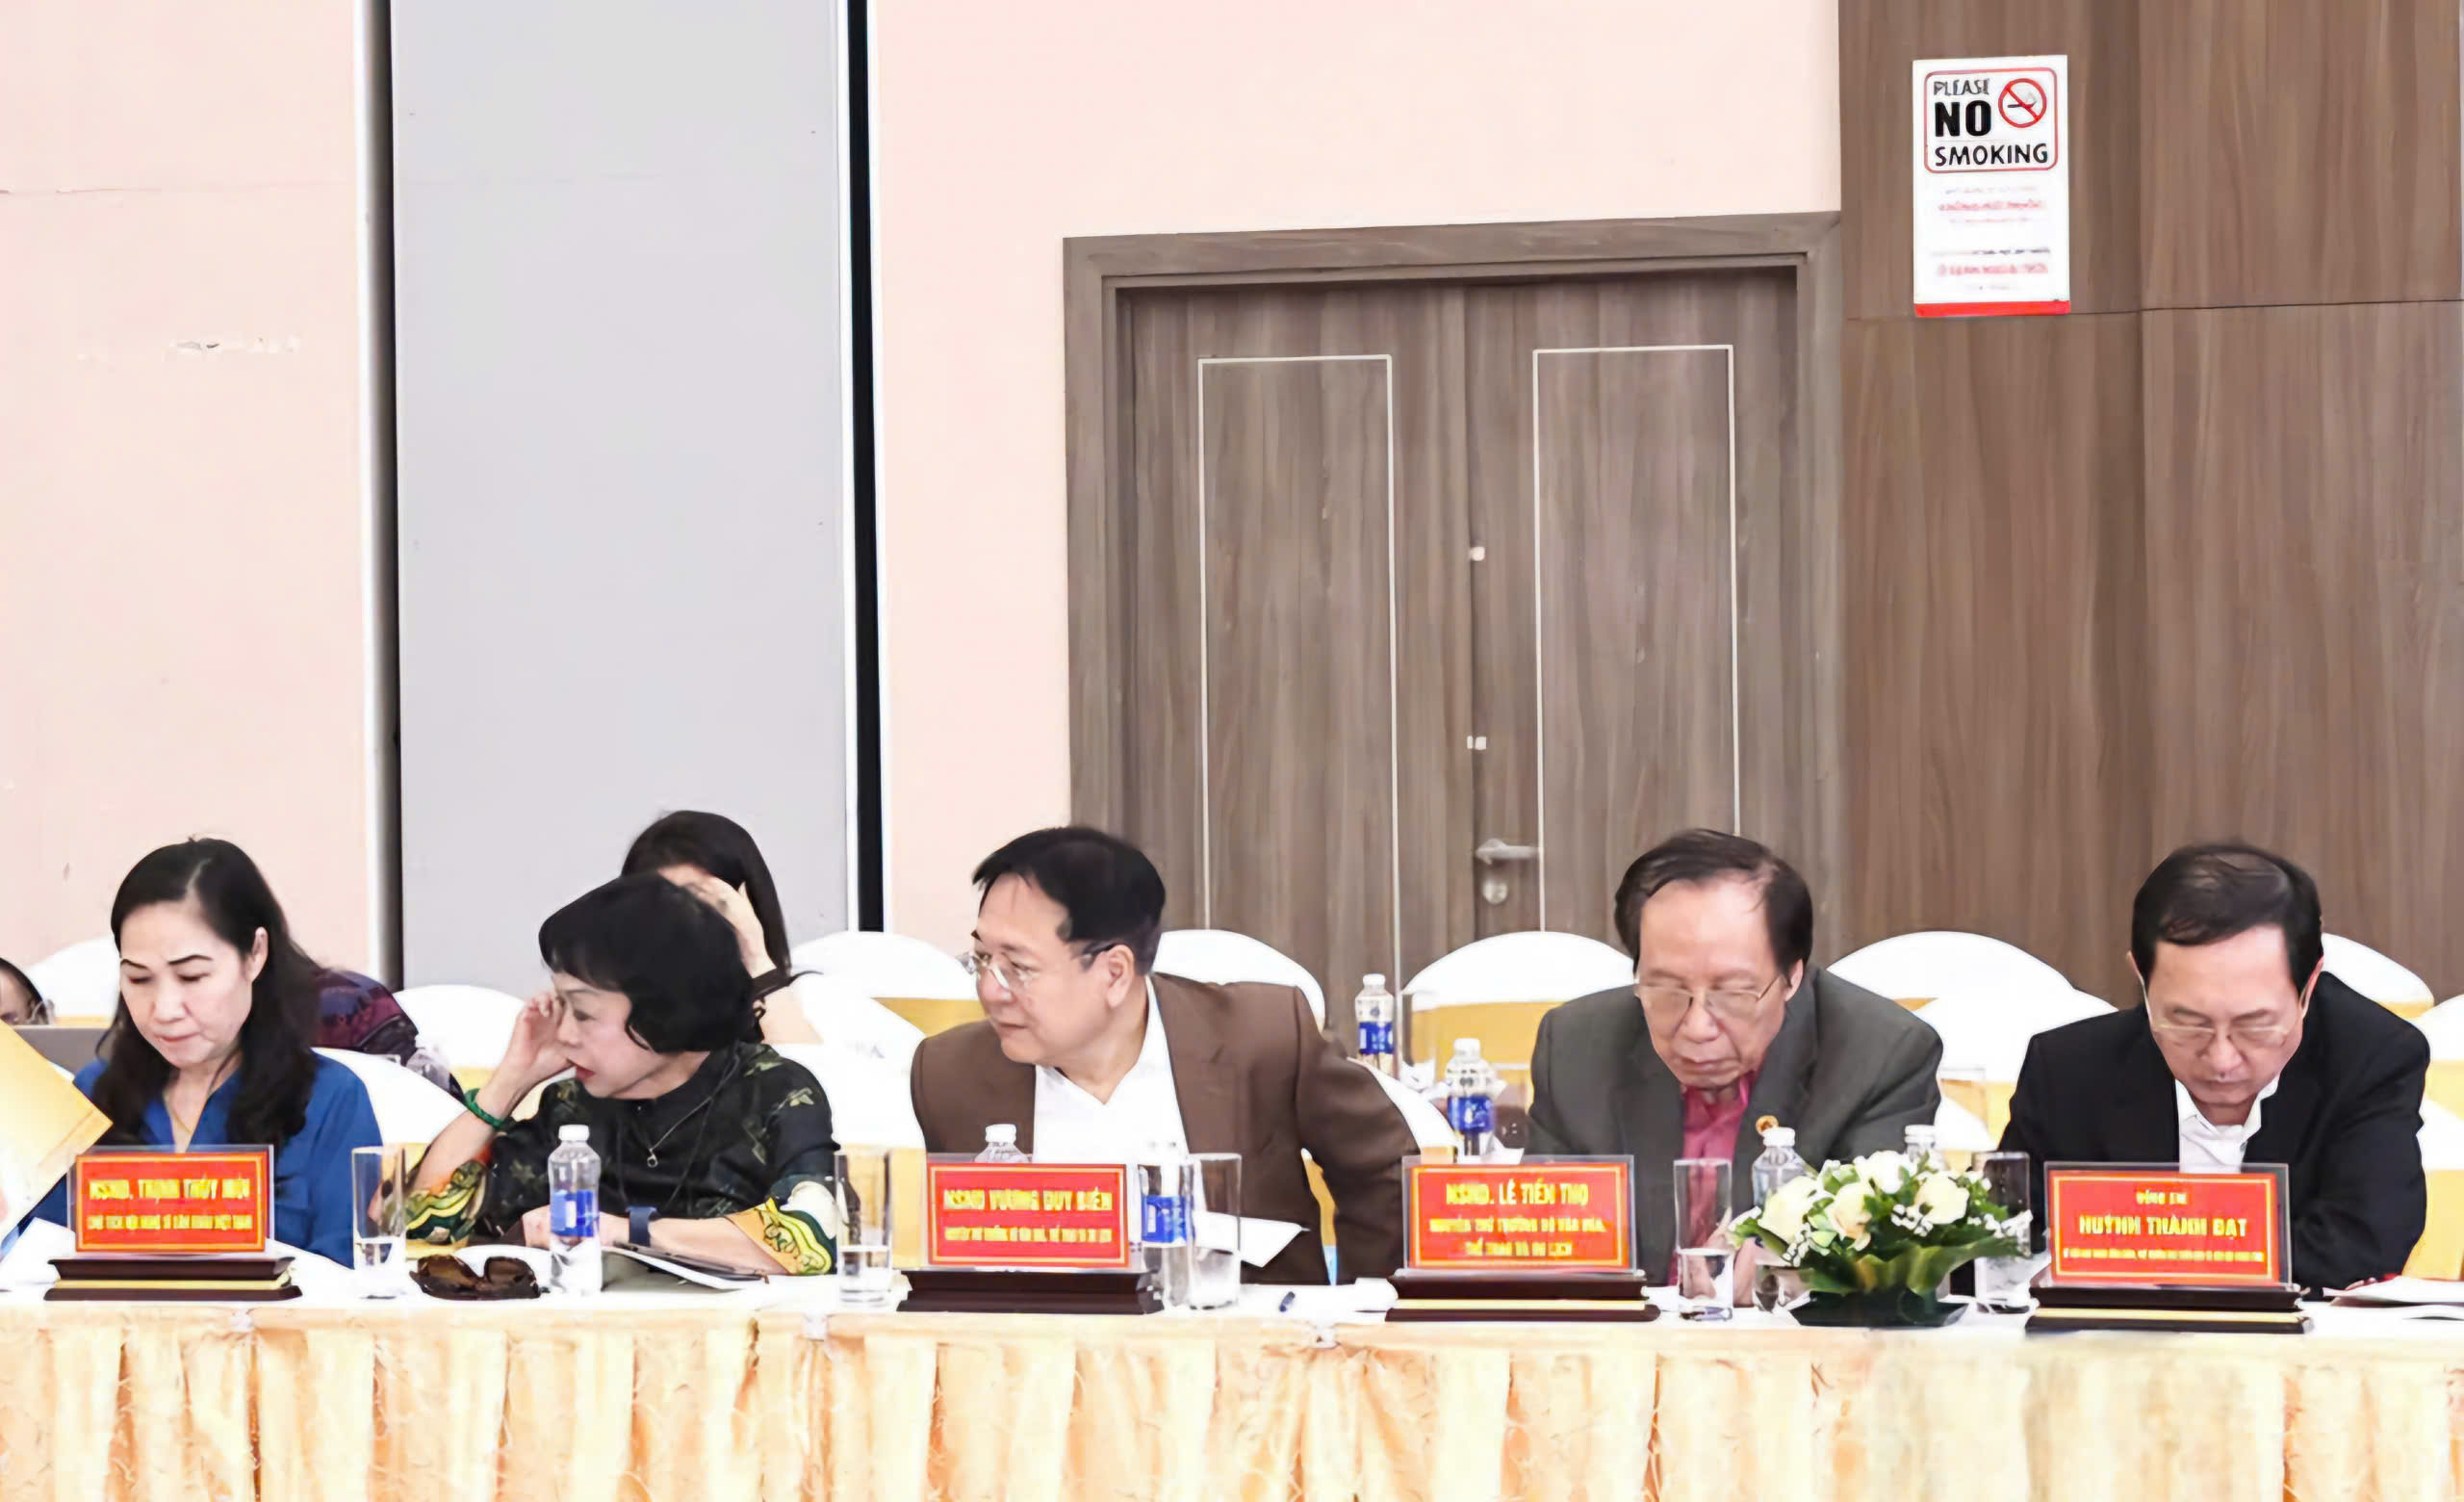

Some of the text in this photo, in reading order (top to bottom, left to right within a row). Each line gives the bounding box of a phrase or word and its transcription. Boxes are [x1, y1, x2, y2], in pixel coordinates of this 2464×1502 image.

[1934, 79, 1989, 96] PLEASE
[1935, 99, 1991, 137] NO
[1935, 143, 2048, 167] SMOKING
